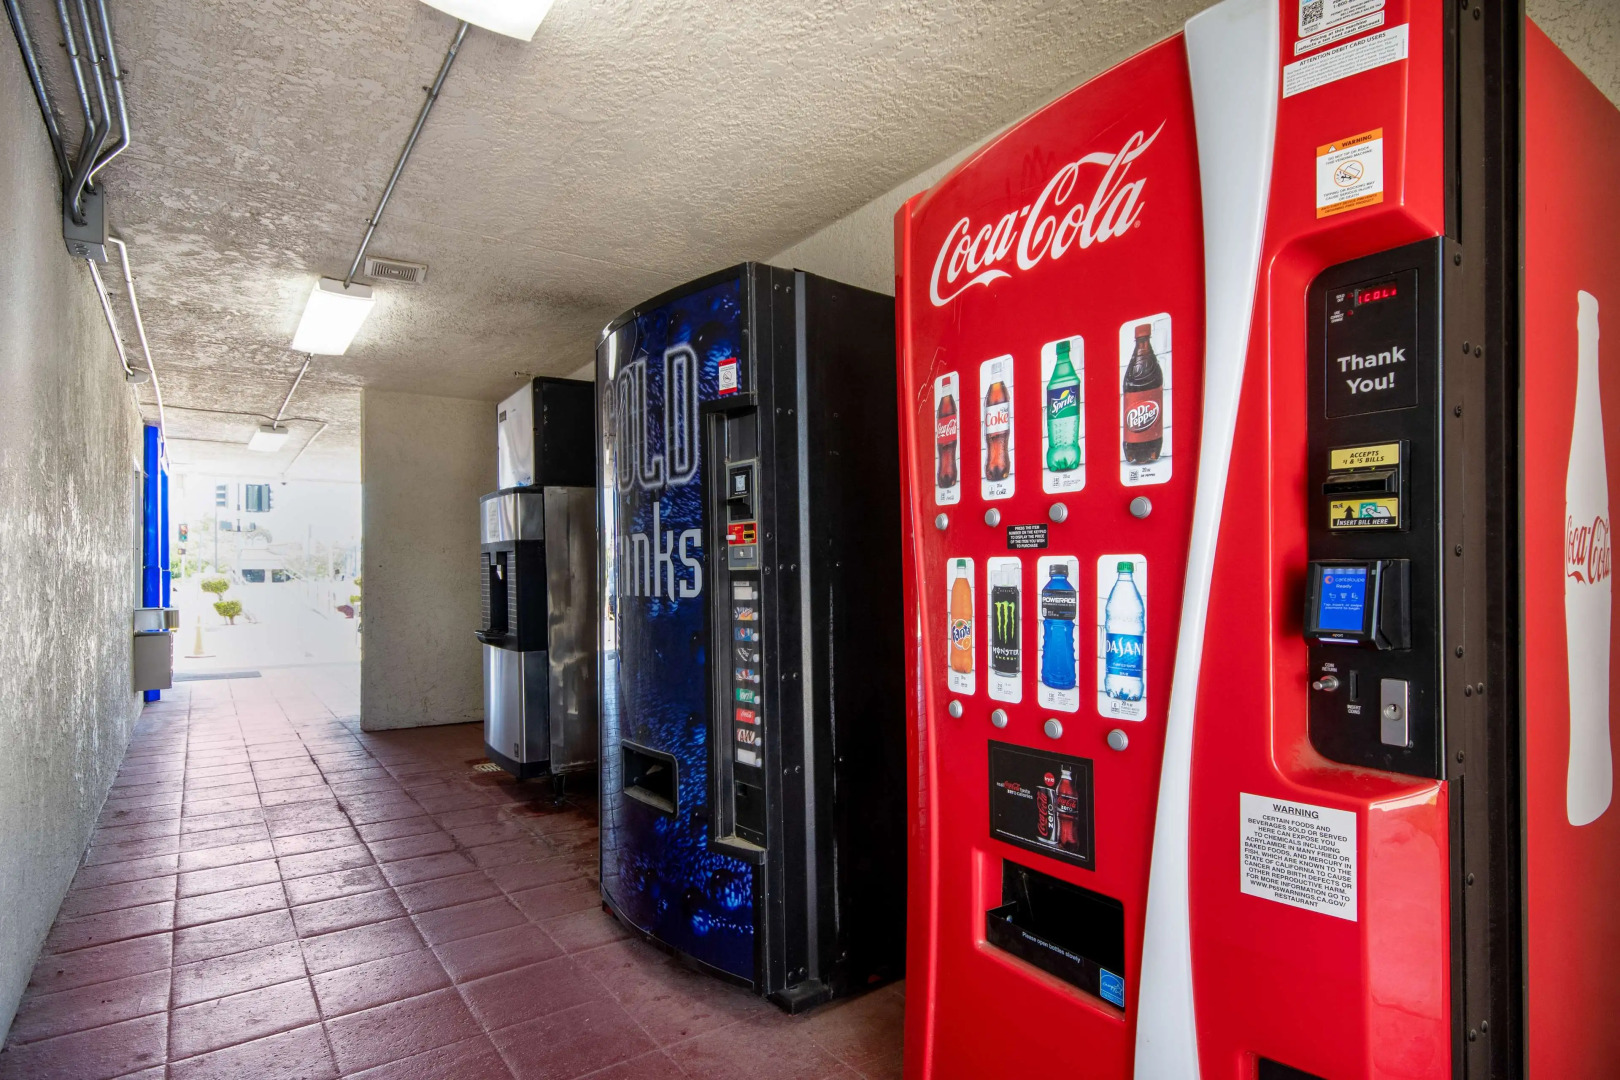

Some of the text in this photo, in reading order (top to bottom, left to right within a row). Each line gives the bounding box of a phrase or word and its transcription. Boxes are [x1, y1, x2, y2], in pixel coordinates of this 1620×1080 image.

[1300, 52, 1330, 66] ATTENTION
[1332, 45, 1348, 54] DEBIT
[1367, 32, 1385, 42] USERS
[1342, 135, 1372, 147] WARNING
[1354, 149, 1372, 158] MACHINE
[930, 118, 1167, 307] Coca-Cola
[1337, 346, 1406, 372] Thank
[1346, 372, 1395, 394] You!
[1051, 394, 1076, 414] Sprite
[1138, 404, 1150, 416] Dr
[985, 410, 1009, 428] Coke
[1129, 408, 1157, 429] Pepper
[1106, 637, 1143, 657] DASANI
[1017, 791, 1033, 800] calories
[1037, 791, 1048, 836] Coca-Cola
[1273, 804, 1319, 819] WARNING
[1248, 818, 1286, 830] BEVERAGES
[1288, 825, 1306, 834] SOLD
[1320, 832, 1347, 842] SERVED
[1263, 815, 1289, 825] CERTAIN
[1291, 821, 1314, 830] FOODS
[1246, 836, 1286, 849] ACRYLAMIDE
[1297, 847, 1315, 856] MANY
[1317, 852, 1337, 860] FRIED
[1264, 834, 1301, 846] CHEMICALS
[1303, 842, 1340, 854] INCLUDING
[1293, 834, 1319, 843] EXPOSE
[1245, 842, 1266, 851] BAKED
[1309, 855, 1342, 867] MERCURY
[1262, 852, 1282, 860] WHICH
[1299, 860, 1325, 870] KNOWN
[1245, 854, 1264, 862] STATE
[1276, 861, 1315, 874] CALIFORNIA
[1328, 872, 1351, 882] CAUSE
[1245, 860, 1270, 871] CANCER
[1287, 869, 1306, 879] BIRTH
[1308, 874, 1340, 886] DEFECTS
[1249, 867, 1270, 876] OTHER
[1272, 873, 1322, 889] REPRODUCTIVE
[1261, 876, 1279, 885] MORE
[1281, 881, 1326, 896] INFORMATION
[1275, 892, 1318, 907] RESTAURANT
[1022, 931, 1081, 963] Please open bottles slowly
